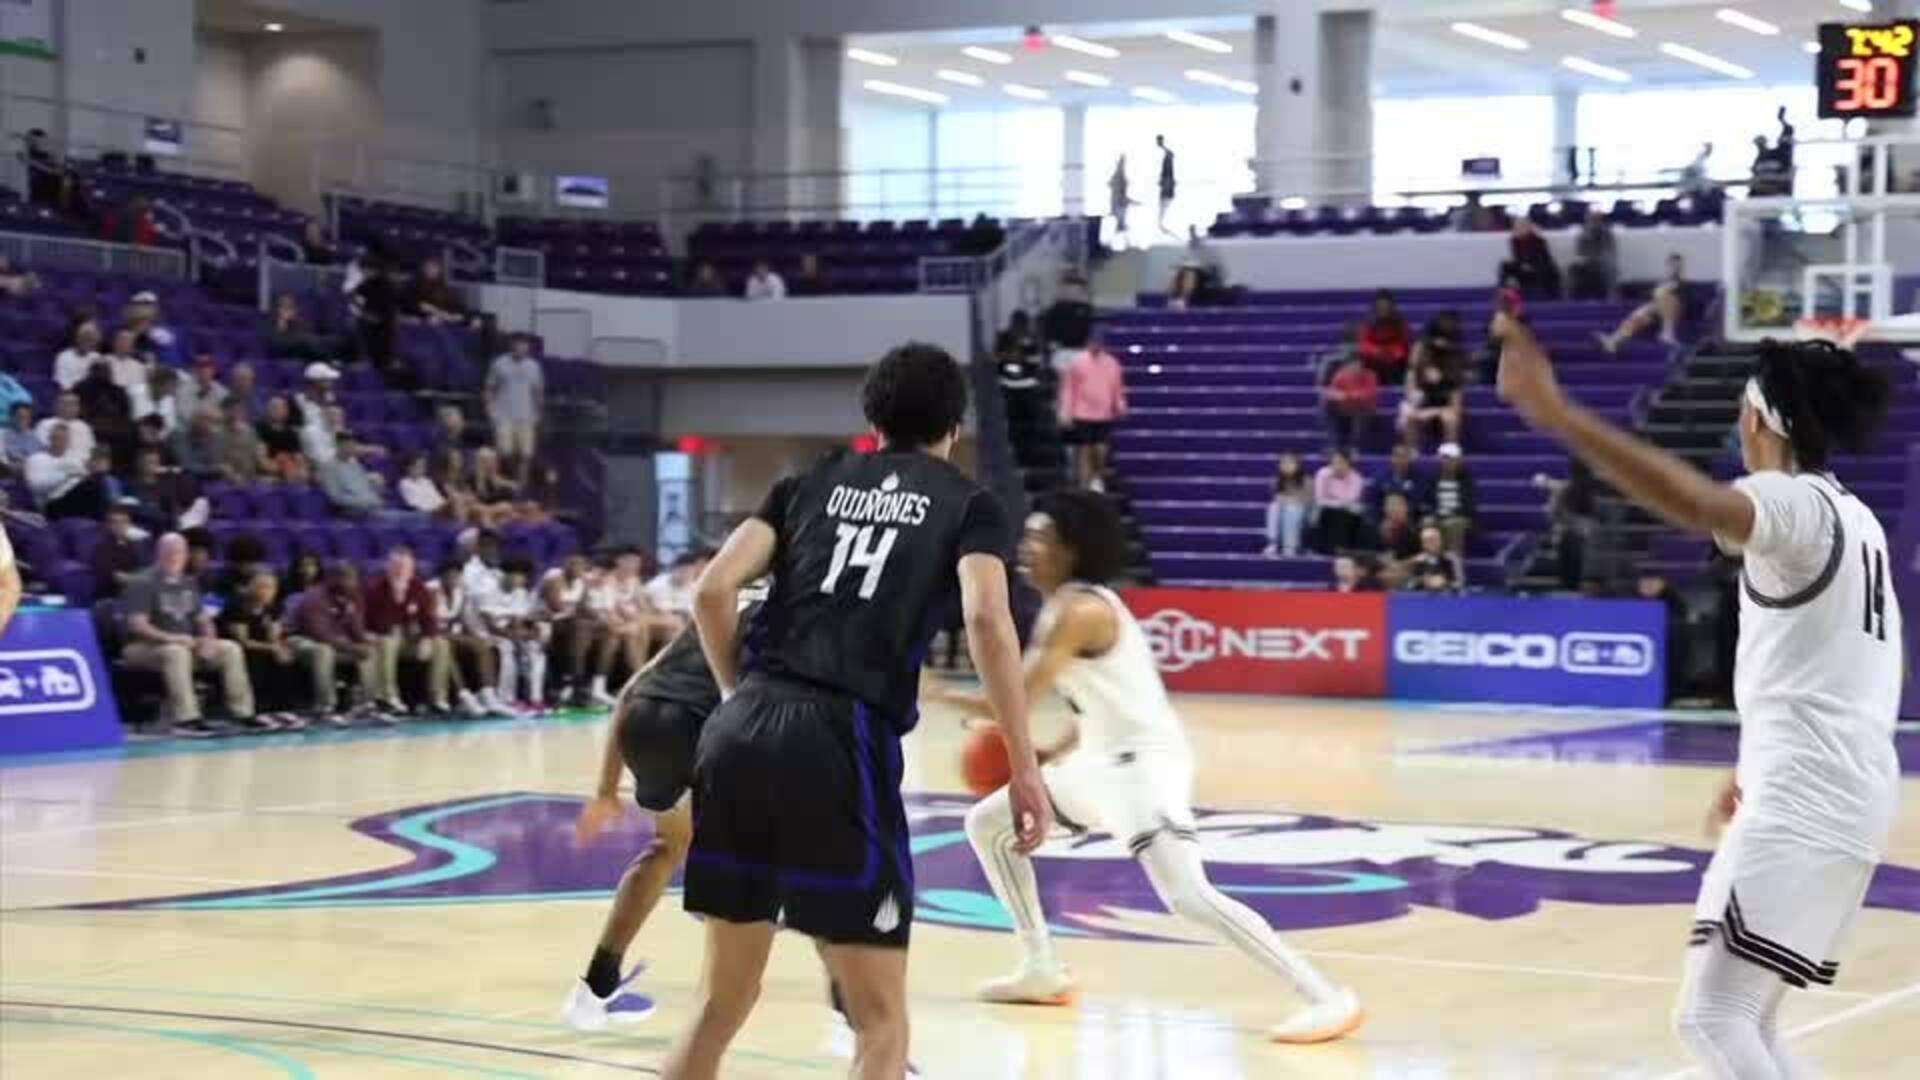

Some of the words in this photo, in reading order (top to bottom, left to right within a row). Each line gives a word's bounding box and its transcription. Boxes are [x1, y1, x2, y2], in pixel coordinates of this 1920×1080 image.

[1835, 57, 1899, 110] 30
[820, 521, 899, 600] 14
[1861, 540, 1886, 641] 14
[1219, 627, 1370, 661] NEXT
[1394, 629, 1557, 669] GEICO
